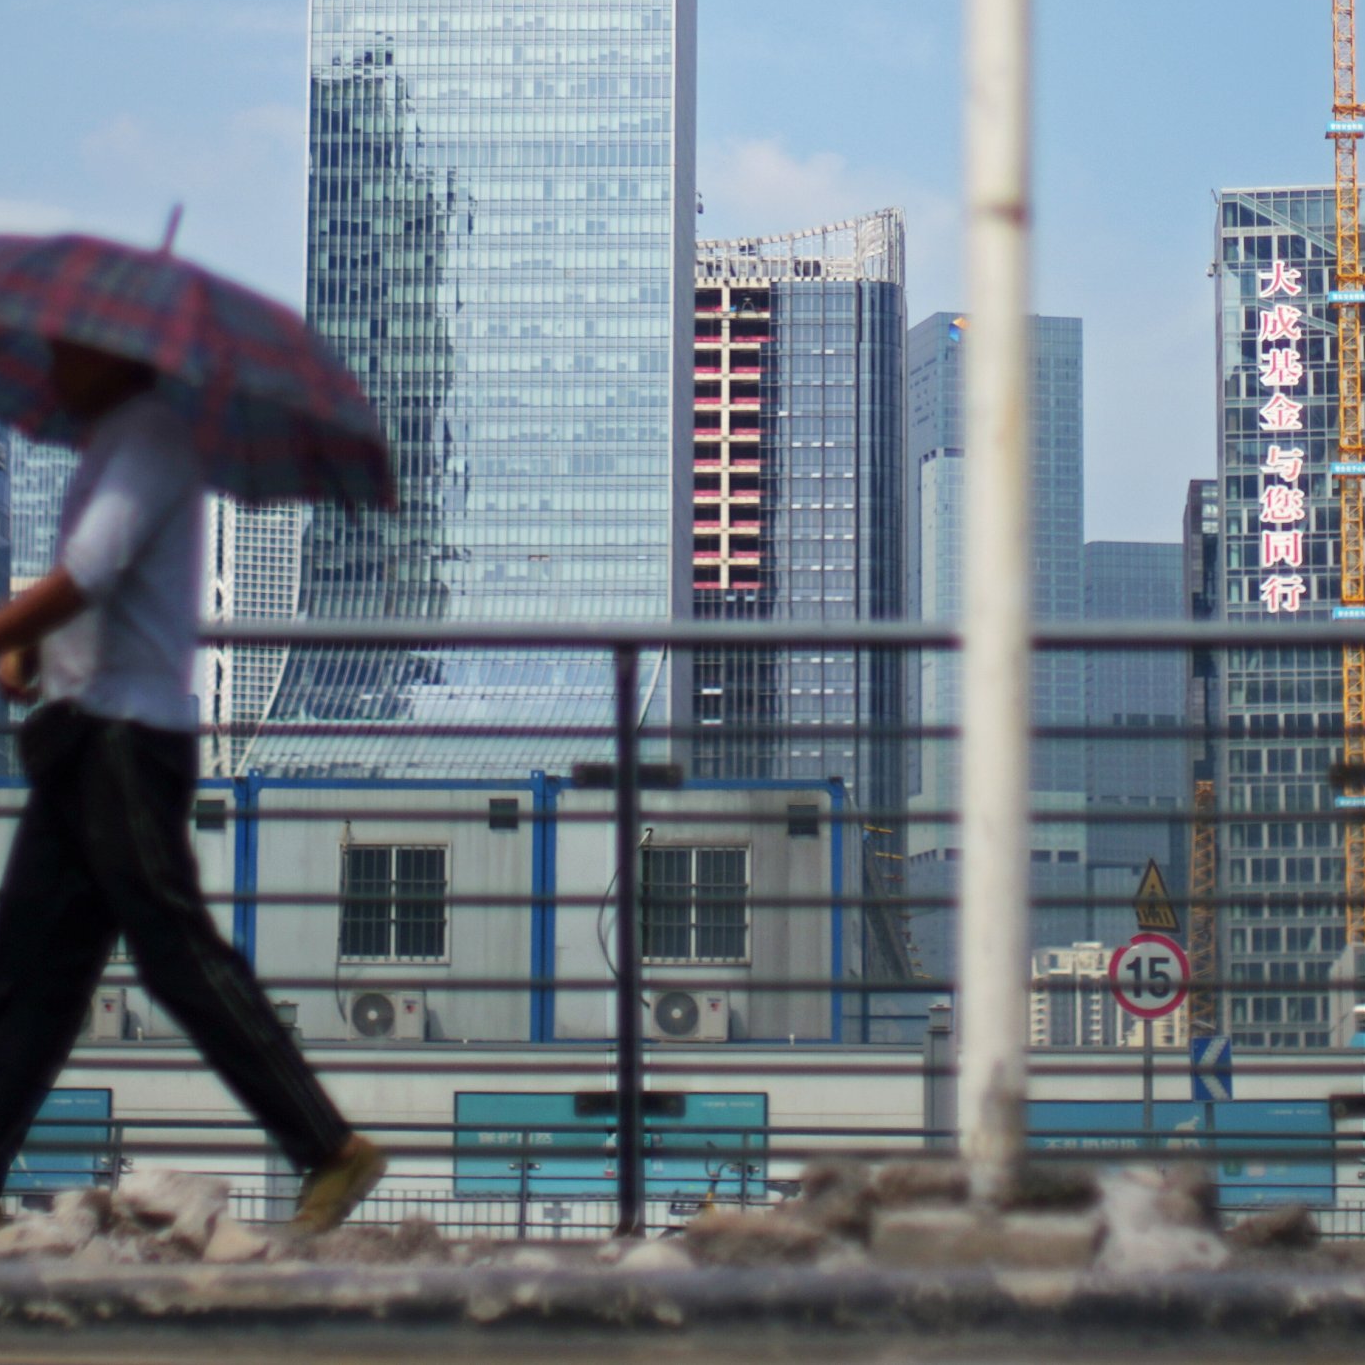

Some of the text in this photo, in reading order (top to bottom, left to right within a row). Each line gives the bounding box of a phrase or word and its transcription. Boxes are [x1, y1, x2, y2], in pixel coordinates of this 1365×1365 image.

[1258, 260, 1306, 613] 大成基金 与您同行
[1126, 956, 1171, 999] 15
